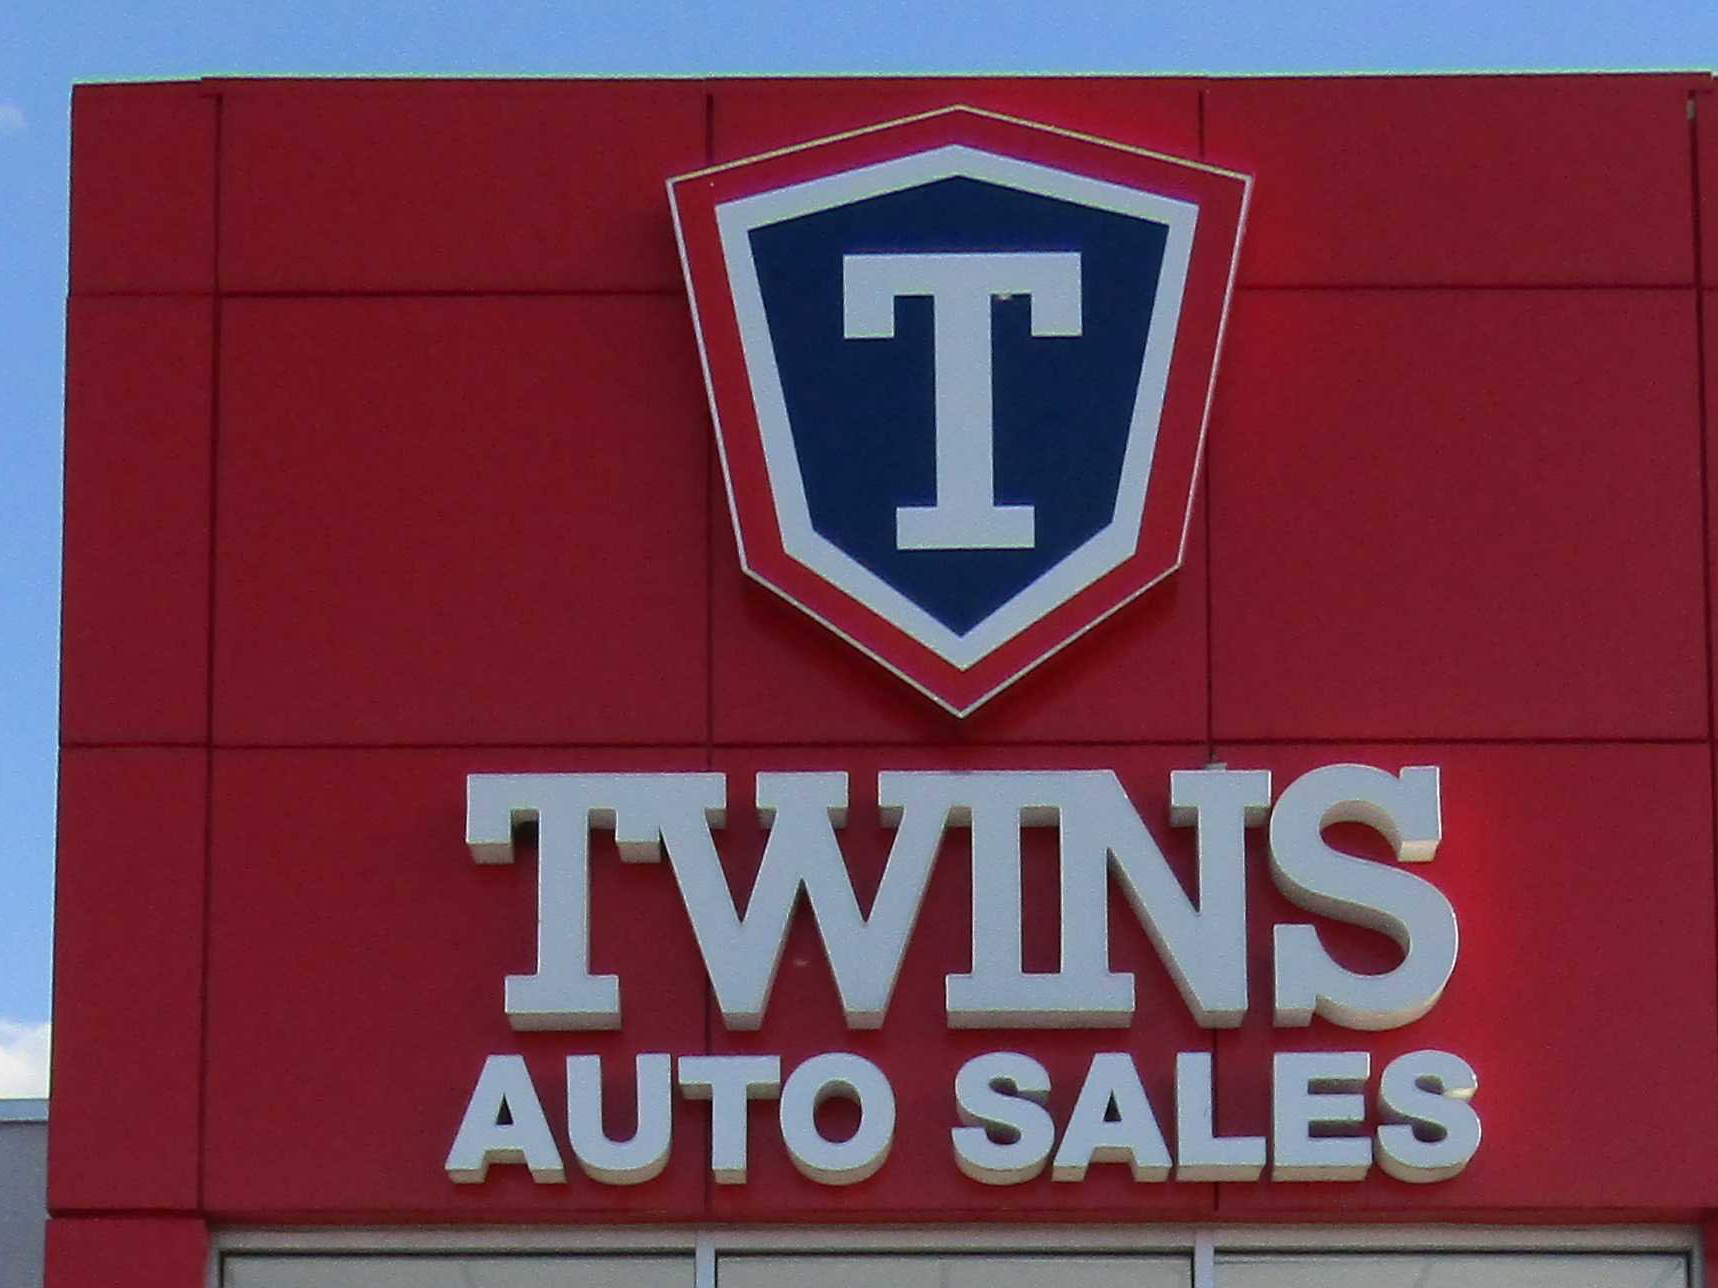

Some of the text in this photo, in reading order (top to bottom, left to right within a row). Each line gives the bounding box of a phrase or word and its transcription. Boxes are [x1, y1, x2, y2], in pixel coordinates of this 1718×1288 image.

[842, 251, 1082, 549] T
[466, 762, 1459, 1031] TWINS
[445, 1049, 1482, 1186] AUTO SALES
